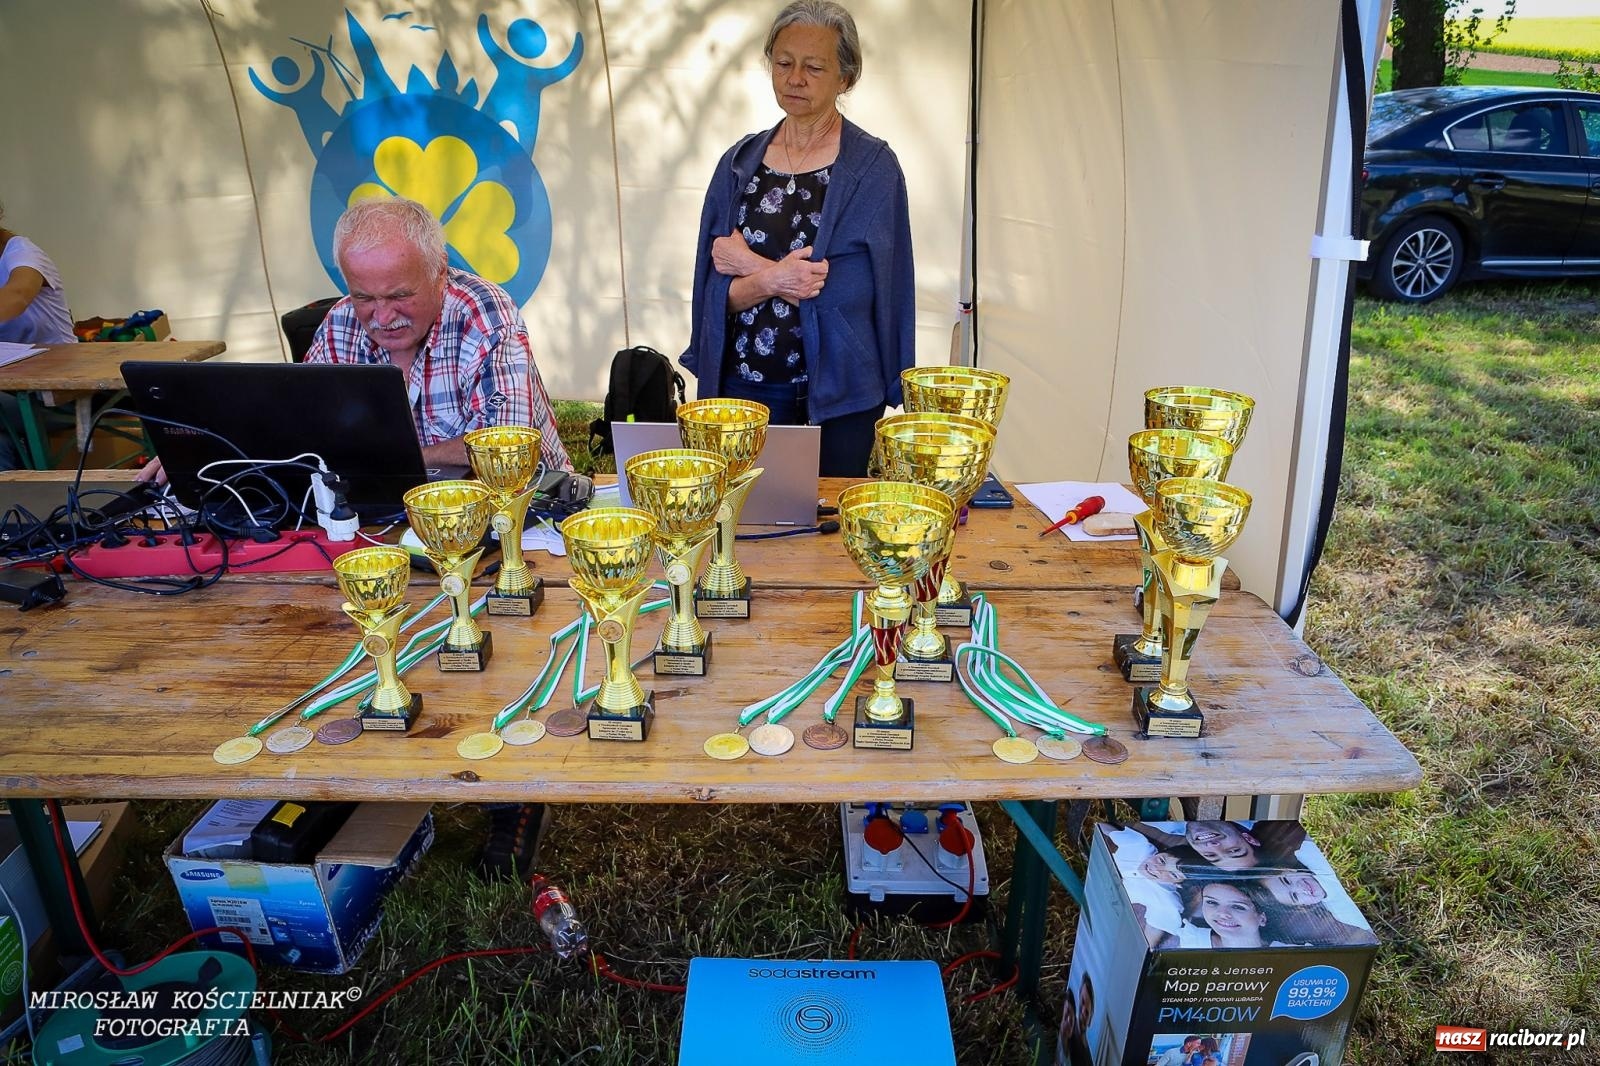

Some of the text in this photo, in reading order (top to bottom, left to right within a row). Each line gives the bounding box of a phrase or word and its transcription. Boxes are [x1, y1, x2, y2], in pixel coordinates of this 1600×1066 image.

[184, 871, 222, 880] SAMSUNG
[748, 967, 876, 980] sodastream
[1167, 967, 1274, 976] Götze & Jensen
[1164, 980, 1270, 994] Mop parowy
[1325, 978, 1338, 986] DO
[1287, 986, 1337, 999] 99,9%
[1287, 998, 1332, 1008] BAKTERII
[1158, 1006, 1262, 1023] PM400W
